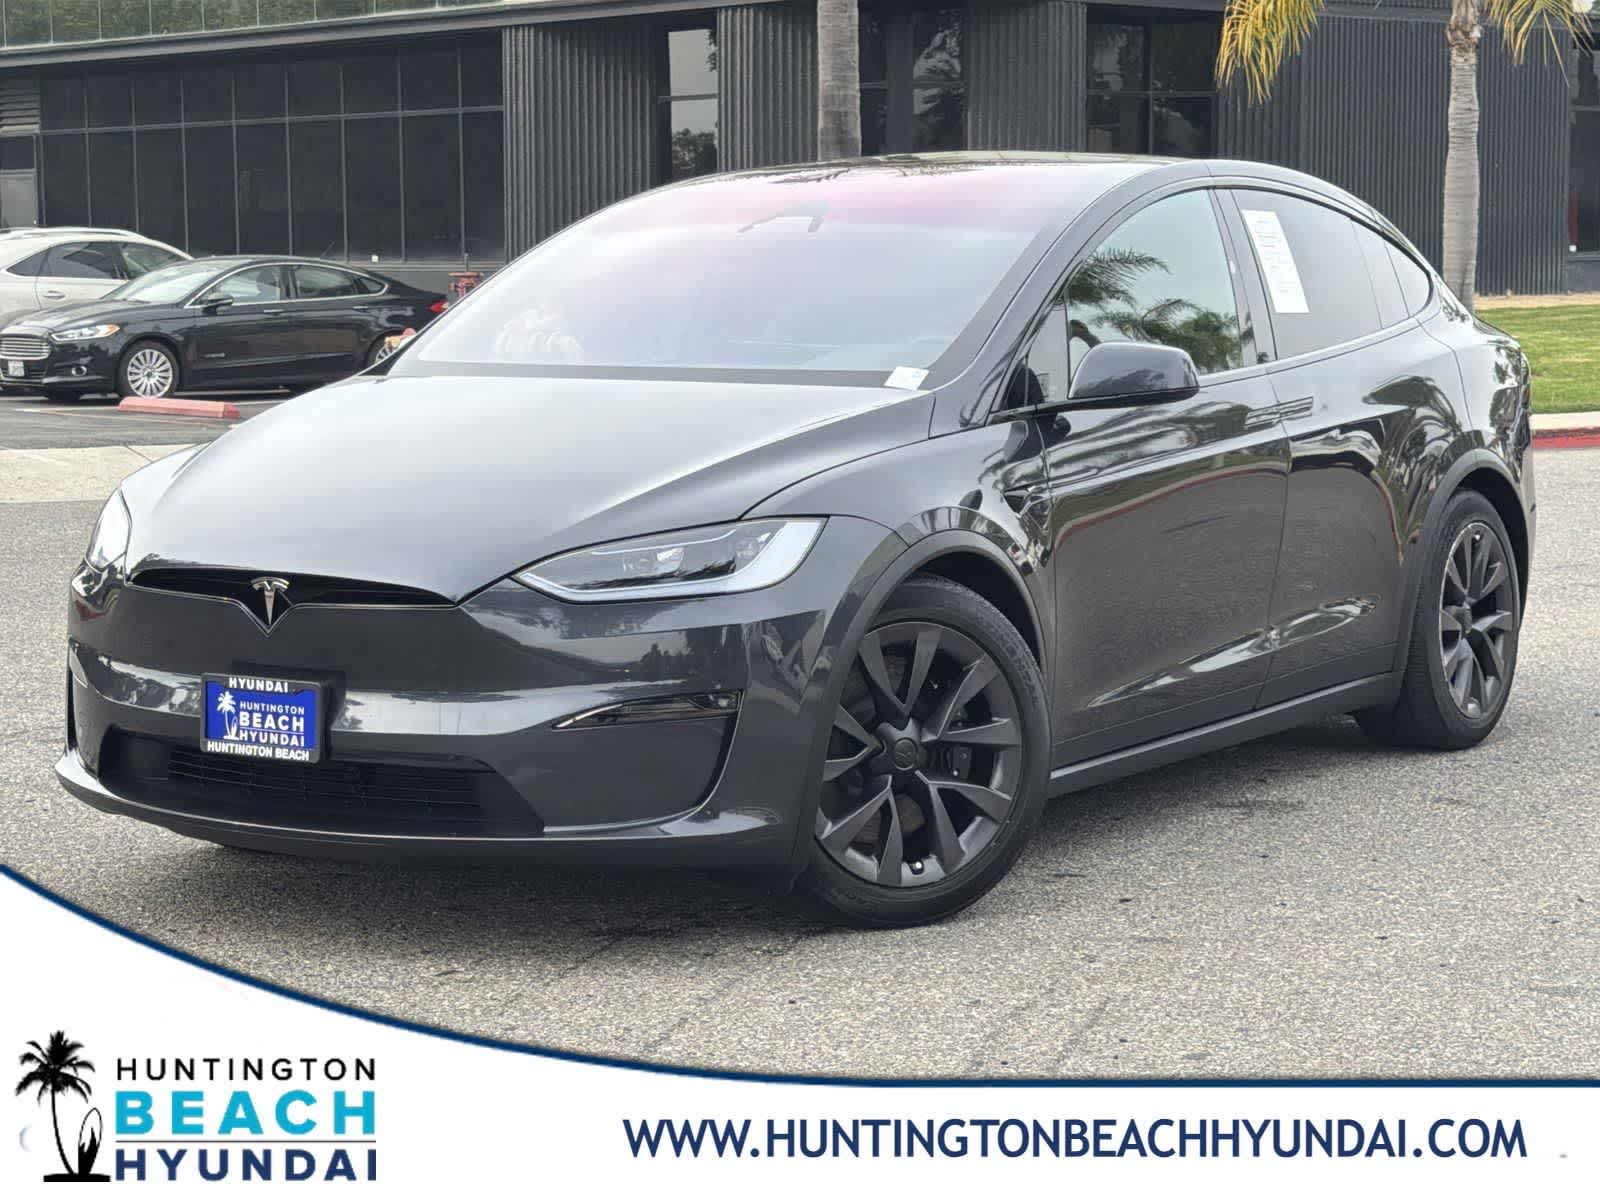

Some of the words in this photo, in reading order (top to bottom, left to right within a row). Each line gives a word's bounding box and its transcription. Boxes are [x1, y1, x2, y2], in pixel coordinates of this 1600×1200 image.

[228, 677, 289, 693] HYUNDAI
[239, 701, 305, 715] HUNTINGTON
[239, 711, 304, 732] BEACH
[240, 730, 305, 747] HYUNDAI
[207, 741, 273, 758] HUNTINGTON
[274, 748, 310, 761] BEACH
